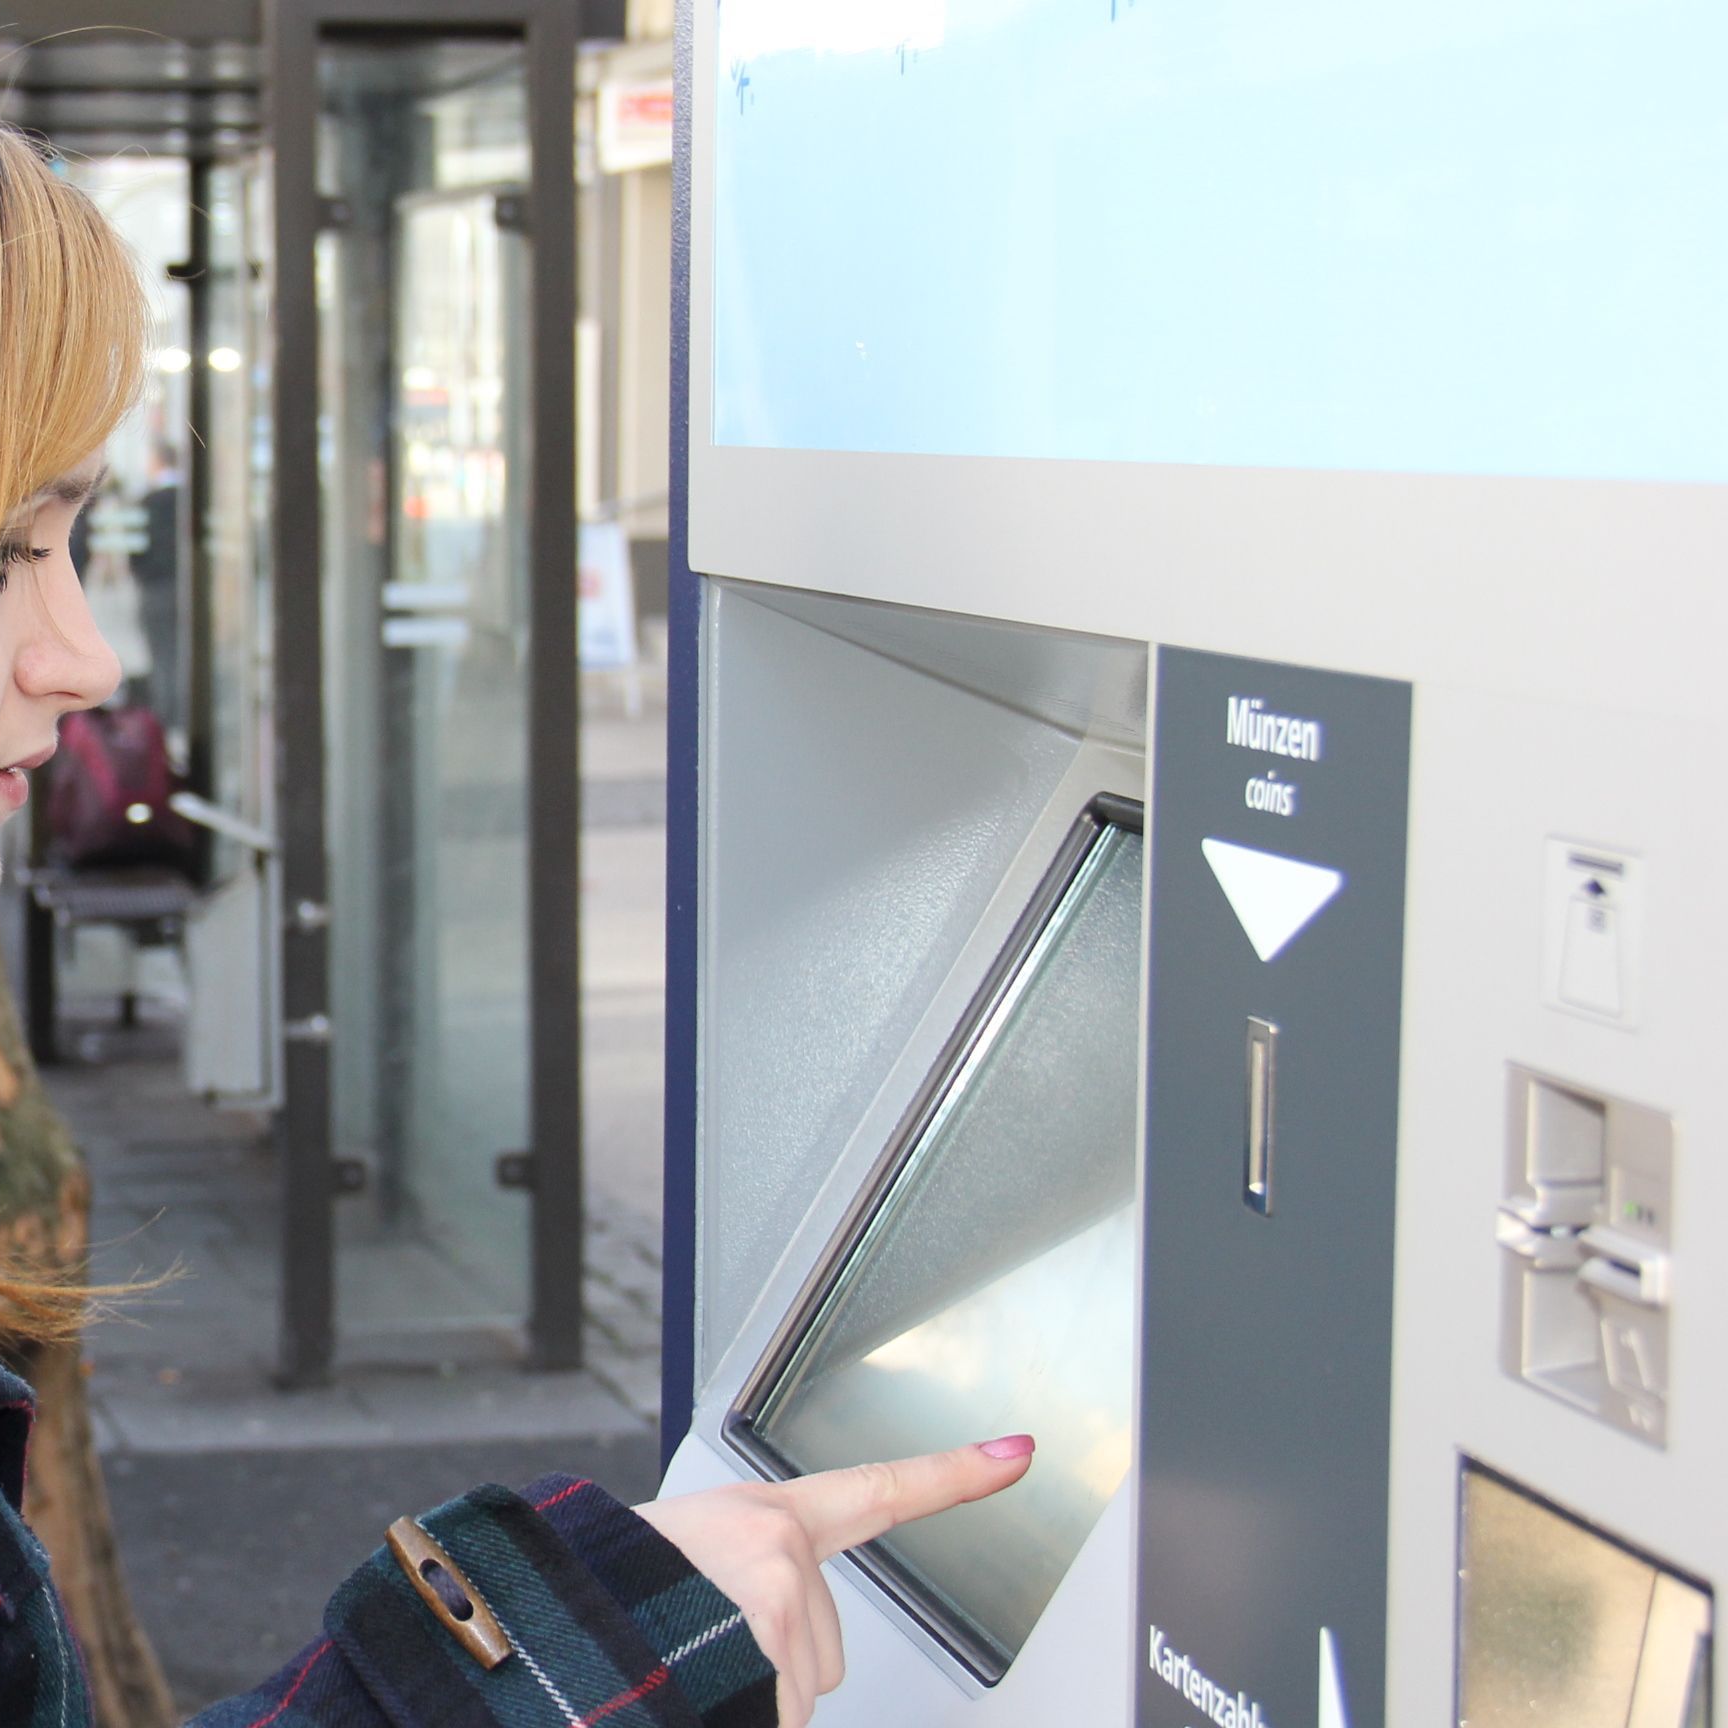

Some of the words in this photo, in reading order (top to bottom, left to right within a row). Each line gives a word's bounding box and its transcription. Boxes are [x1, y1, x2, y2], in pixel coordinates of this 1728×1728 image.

[1226, 696, 1320, 761] Münzen
[1245, 770, 1296, 816] coins
[1149, 1624, 1266, 1728] Kartenzahl
